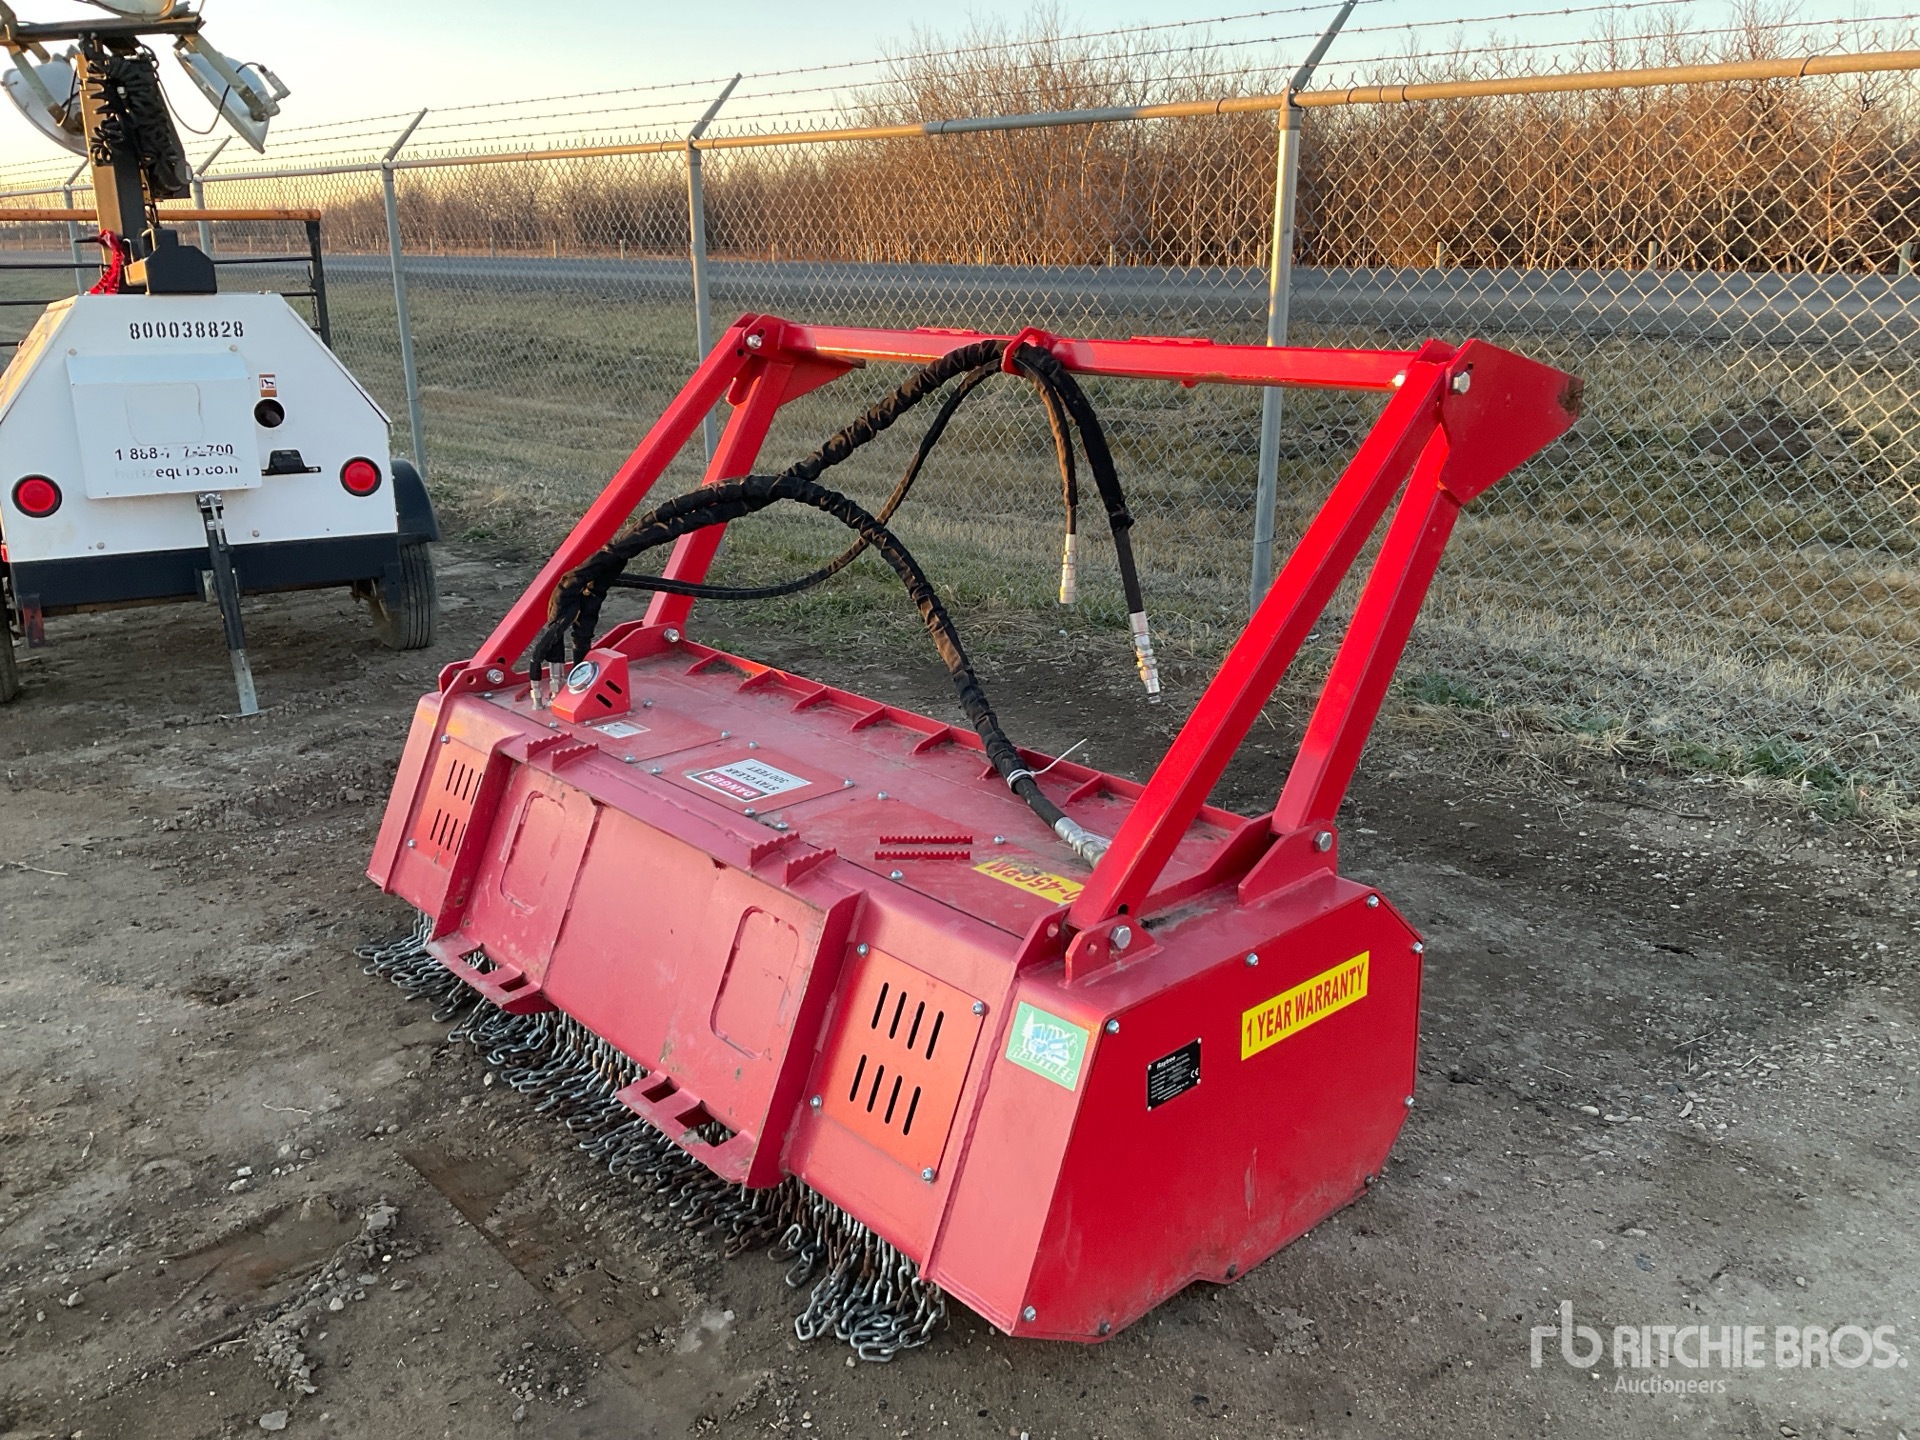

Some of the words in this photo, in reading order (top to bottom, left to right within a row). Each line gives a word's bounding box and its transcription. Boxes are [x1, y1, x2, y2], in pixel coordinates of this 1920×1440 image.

[129, 321, 244, 340] 800038828
[115, 448, 122, 460] 1
[725, 767, 755, 782] CLEAR
[746, 766, 771, 778] FEET
[703, 773, 757, 797] DANGER
[755, 780, 780, 792] STAY
[1246, 1018, 1253, 1047] 1
[1257, 1000, 1292, 1042] YEAR
[1295, 962, 1365, 1022] WARRANTY
